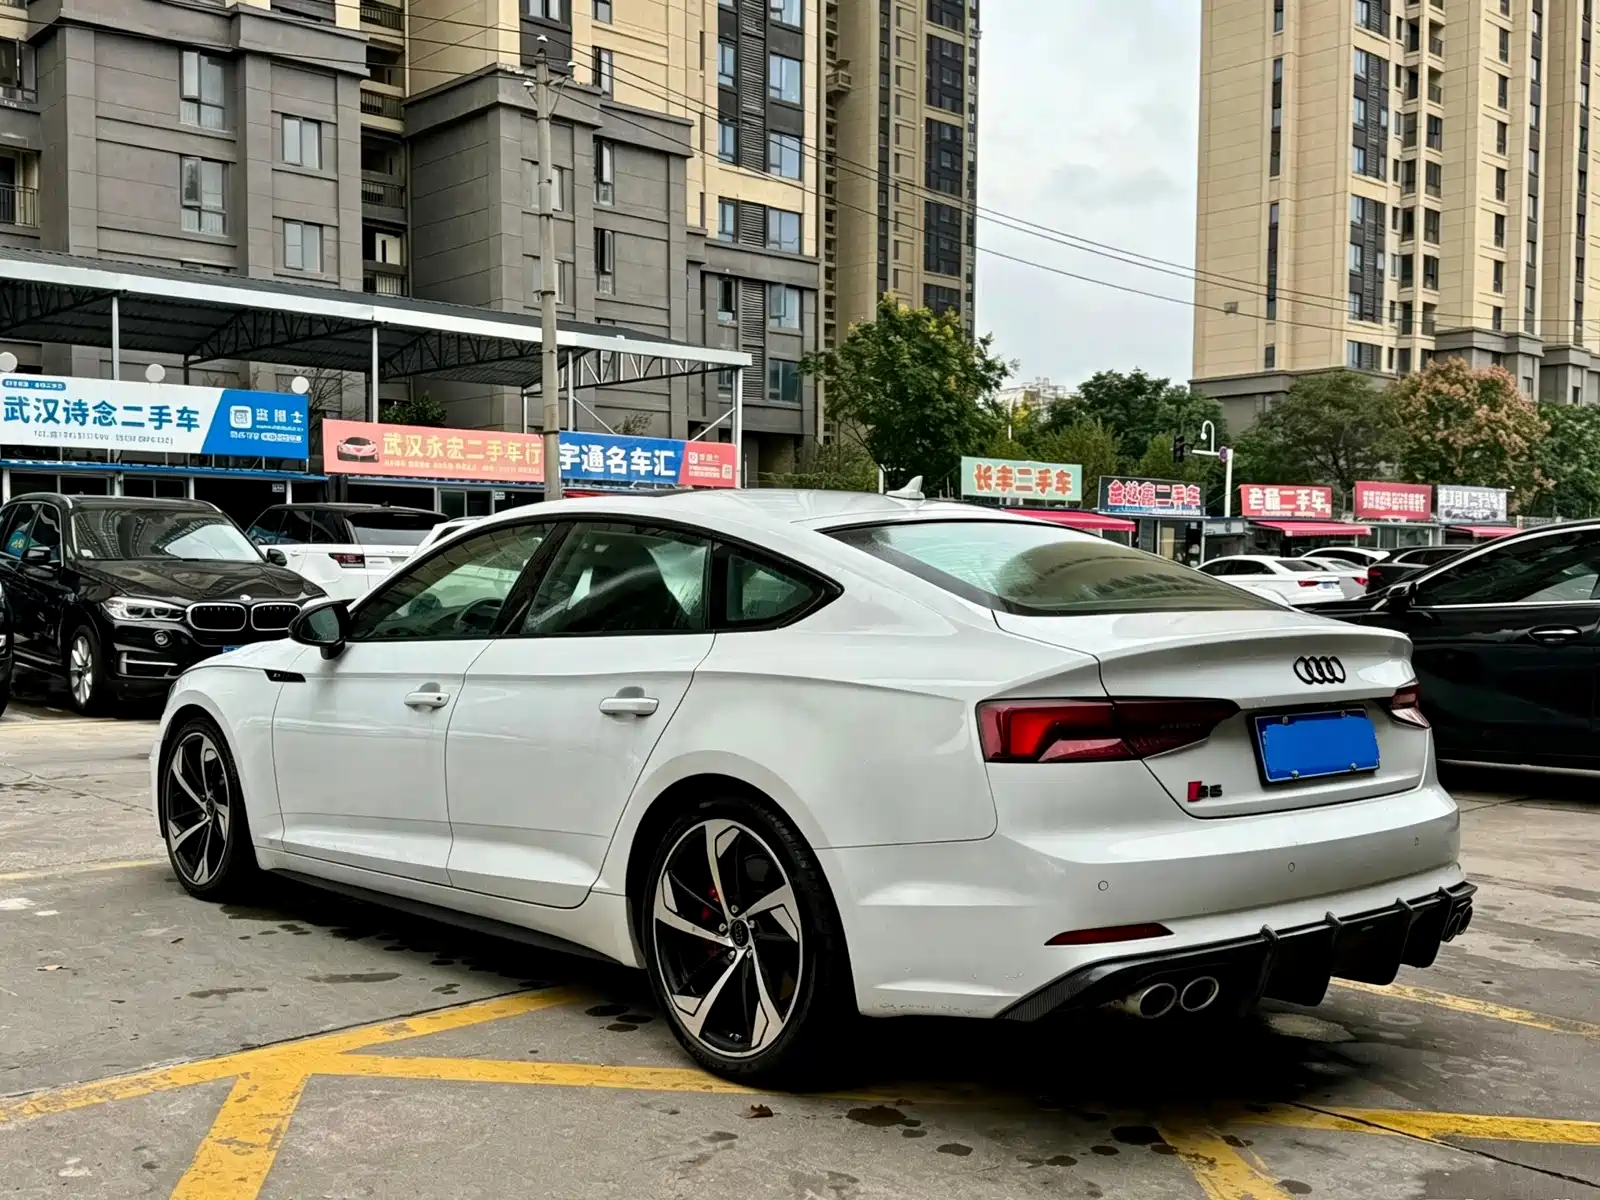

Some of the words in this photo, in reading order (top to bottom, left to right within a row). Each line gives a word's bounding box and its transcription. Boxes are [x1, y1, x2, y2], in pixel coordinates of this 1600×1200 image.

[3, 395, 201, 433] 武汉诗念二手车
[973, 462, 1074, 496] 长丰二手车
